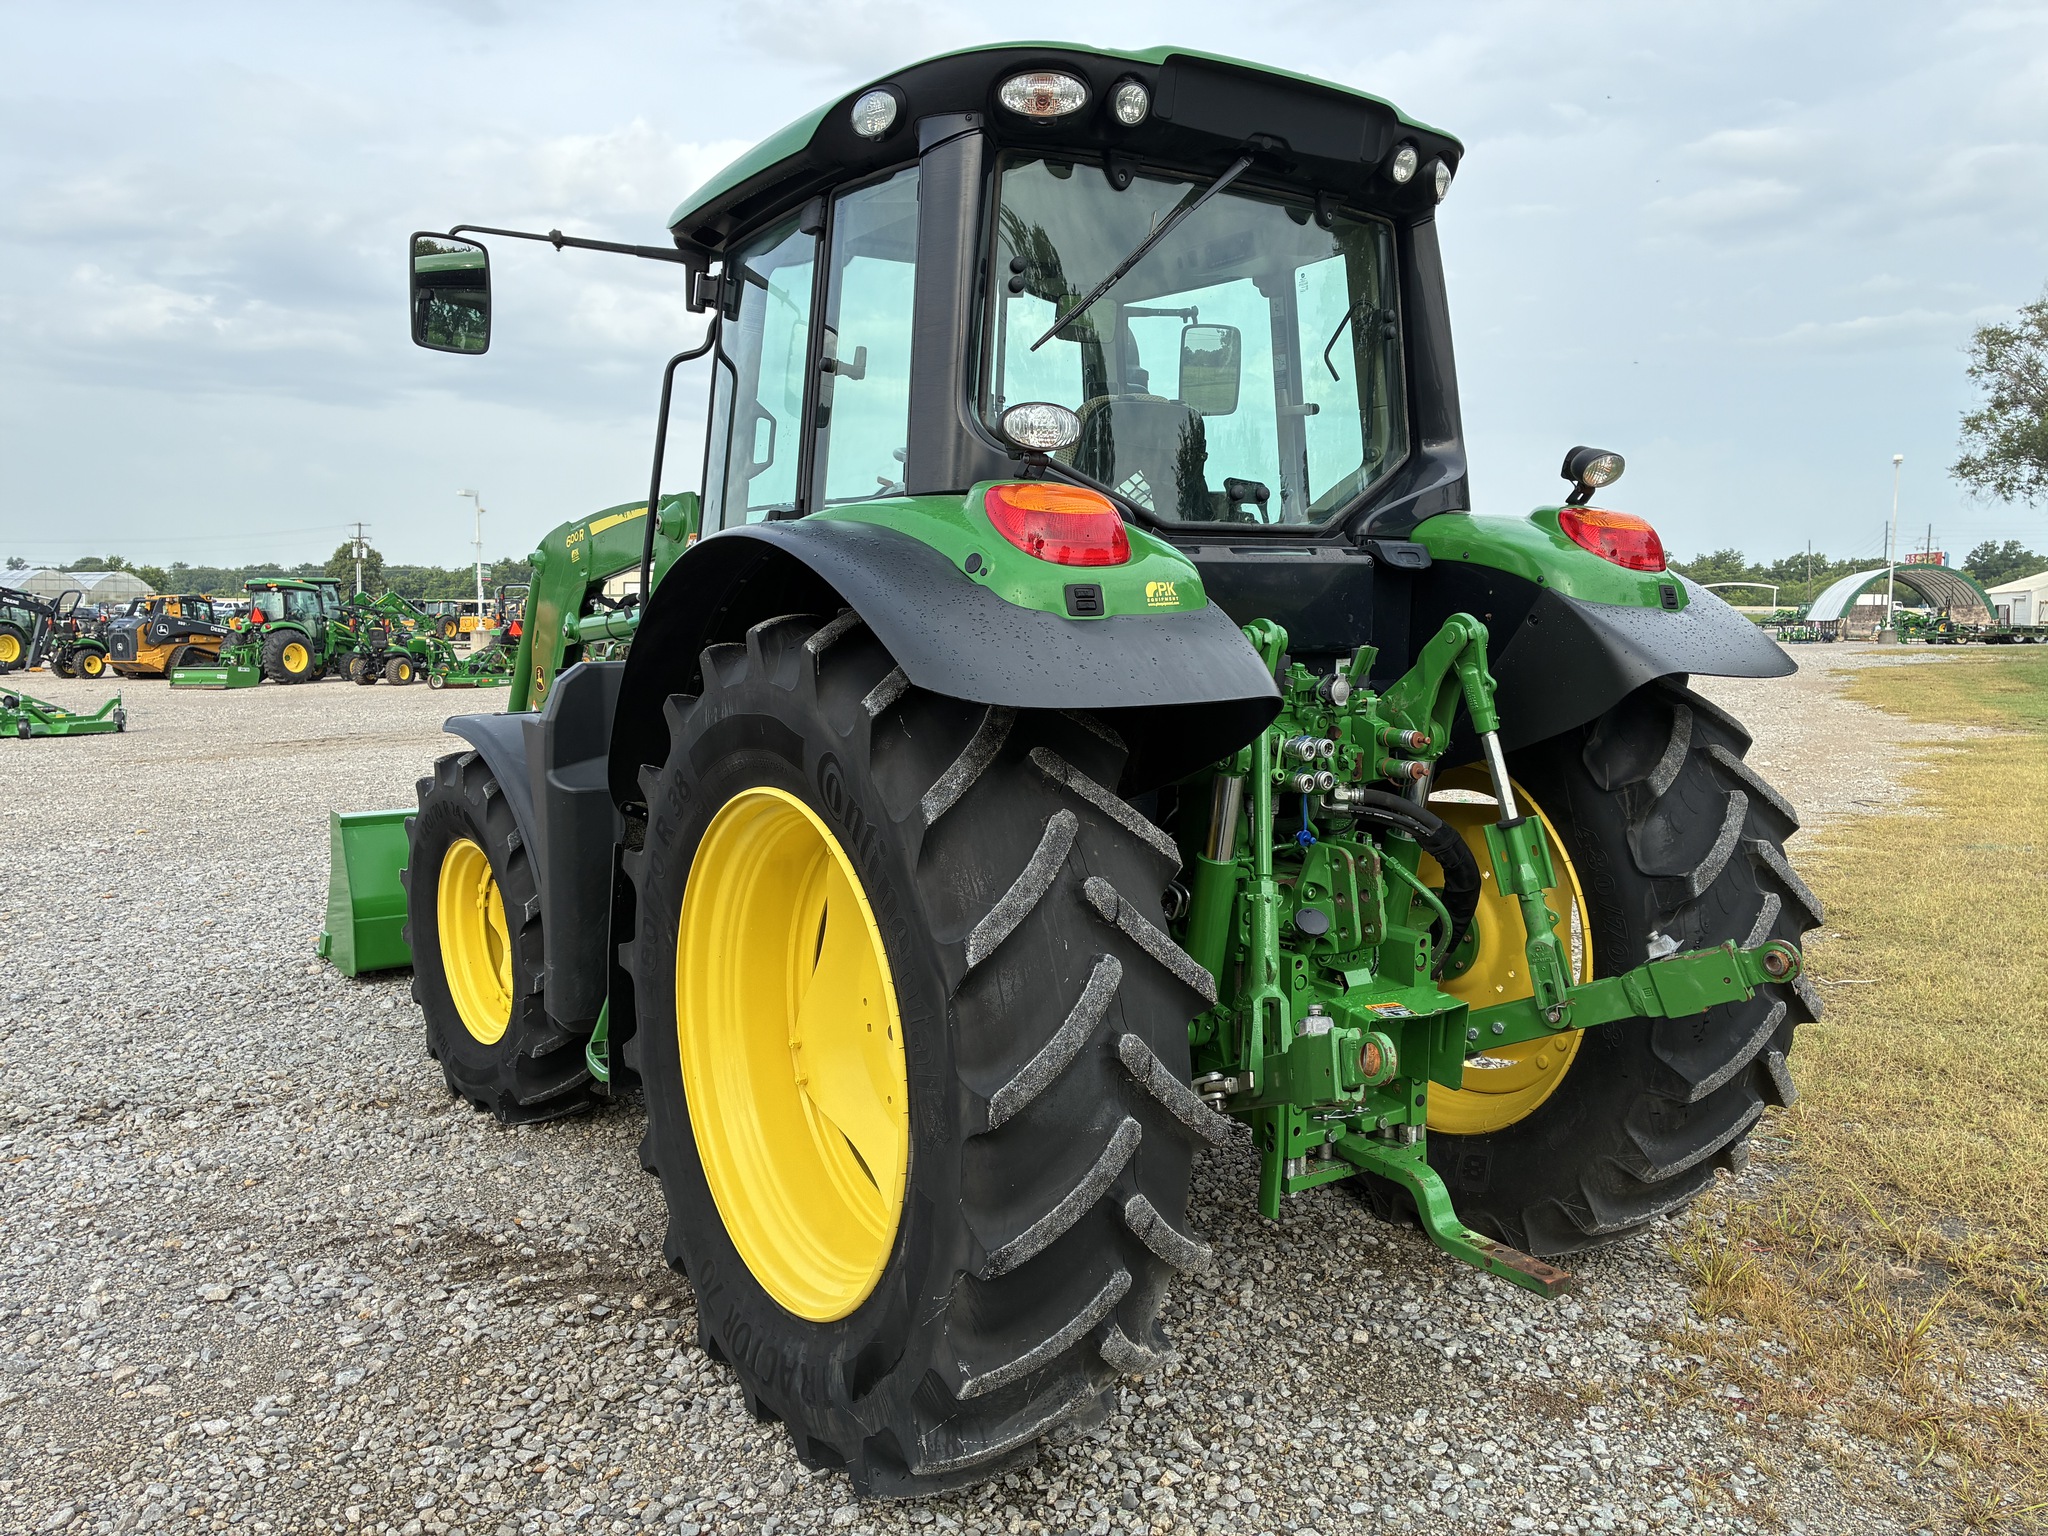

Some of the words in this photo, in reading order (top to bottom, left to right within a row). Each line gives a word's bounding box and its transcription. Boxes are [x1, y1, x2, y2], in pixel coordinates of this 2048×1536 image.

[1156, 582, 1177, 596] PK
[2, 597, 20, 605] DEERE
[210, 626, 228, 634] DEERE
[442, 800, 451, 815] R
[451, 801, 462, 820] 24
[654, 814, 677, 851] R
[668, 768, 692, 821] 38
[699, 1258, 724, 1319] 70
